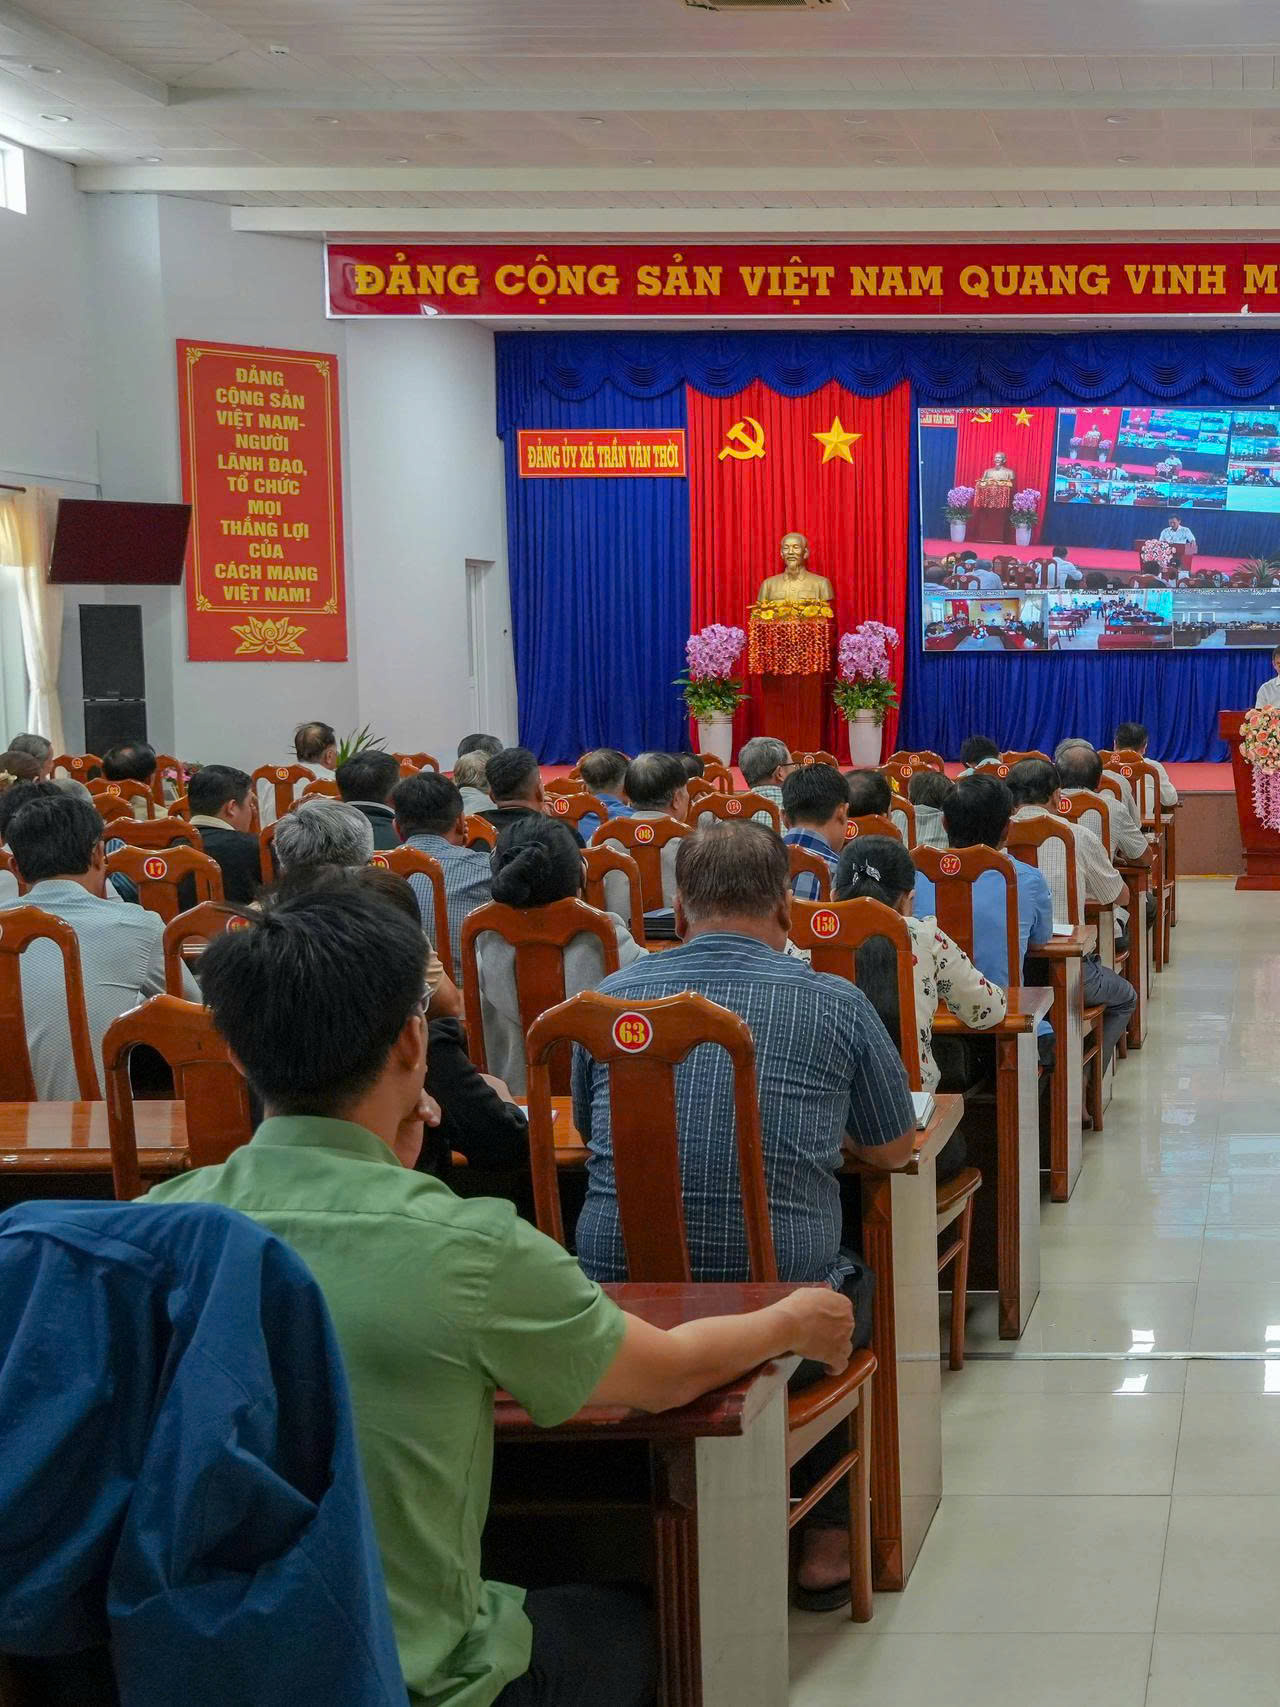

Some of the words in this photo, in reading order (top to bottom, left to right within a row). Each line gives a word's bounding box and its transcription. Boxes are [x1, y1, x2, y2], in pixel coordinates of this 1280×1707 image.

[354, 253, 480, 295] ĐẢNG
[495, 254, 620, 304] CỘNG
[637, 253, 723, 296] SẢN
[739, 256, 835, 305] VIỆT
[850, 266, 943, 296] NAM
[959, 265, 1110, 298] QUANG
[1124, 265, 1226, 294] VINH
[235, 364, 284, 386] ĐẢNG
[215, 386, 264, 407] CỘNG
[270, 389, 304, 409] SẢN
[216, 408, 253, 430] VIỆT
[258, 413, 306, 431] NAM-
[235, 433, 288, 452] NGƯỜI
[527, 438, 560, 468] ĐẢNG
[563, 438, 577, 468] ỦY
[579, 442, 596, 468] XÃ
[597, 437, 626, 468] TRẦN
[629, 440, 650, 468] VĂN
[653, 439, 679, 468] THỜI
[218, 452, 264, 471] LÃNH
[269, 457, 307, 476] ĐẠO,
[227, 472, 248, 492] TỔ
[254, 474, 300, 495] CHỨC
[248, 500, 281, 518] MỌI
[220, 516, 278, 537] THẮNG
[282, 523, 309, 541] LỢI
[249, 538, 284, 559] CỦA
[215, 561, 261, 579] CÁCH
[267, 565, 318, 583] MẠNG
[223, 583, 259, 604] VIỆT
[264, 587, 311, 602] NAM!
[149, 862, 162, 875] 17
[943, 857, 957, 869] 37
[816, 916, 835, 936] 158
[619, 1022, 644, 1044] 63
